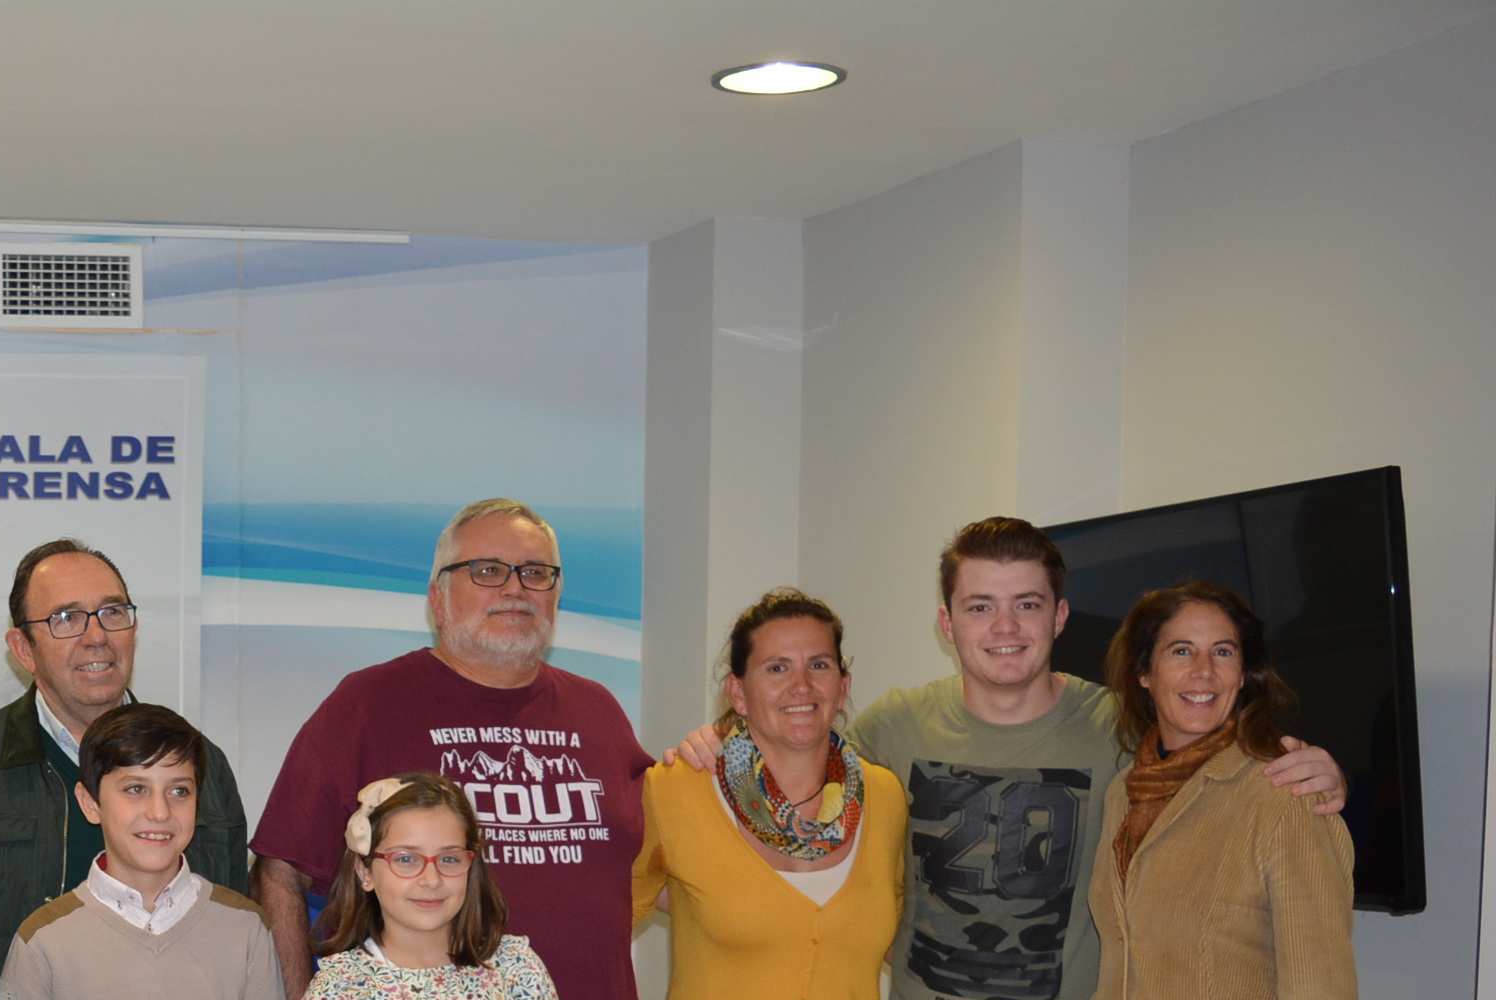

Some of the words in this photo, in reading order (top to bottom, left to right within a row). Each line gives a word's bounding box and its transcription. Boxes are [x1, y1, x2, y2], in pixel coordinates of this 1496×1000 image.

[111, 435, 175, 464] DE
[429, 727, 477, 745] NEVER
[479, 727, 522, 743] MESS
[524, 729, 566, 746] WITH
[570, 732, 581, 748] A
[455, 782, 600, 823] COUT
[485, 828, 526, 842] PLACES
[528, 829, 568, 842] WHERE
[570, 828, 586, 840] NO
[589, 828, 610, 840] ONE
[918, 776, 1080, 899] 20
[503, 845, 545, 864] FIND
[548, 845, 583, 864] YOU
